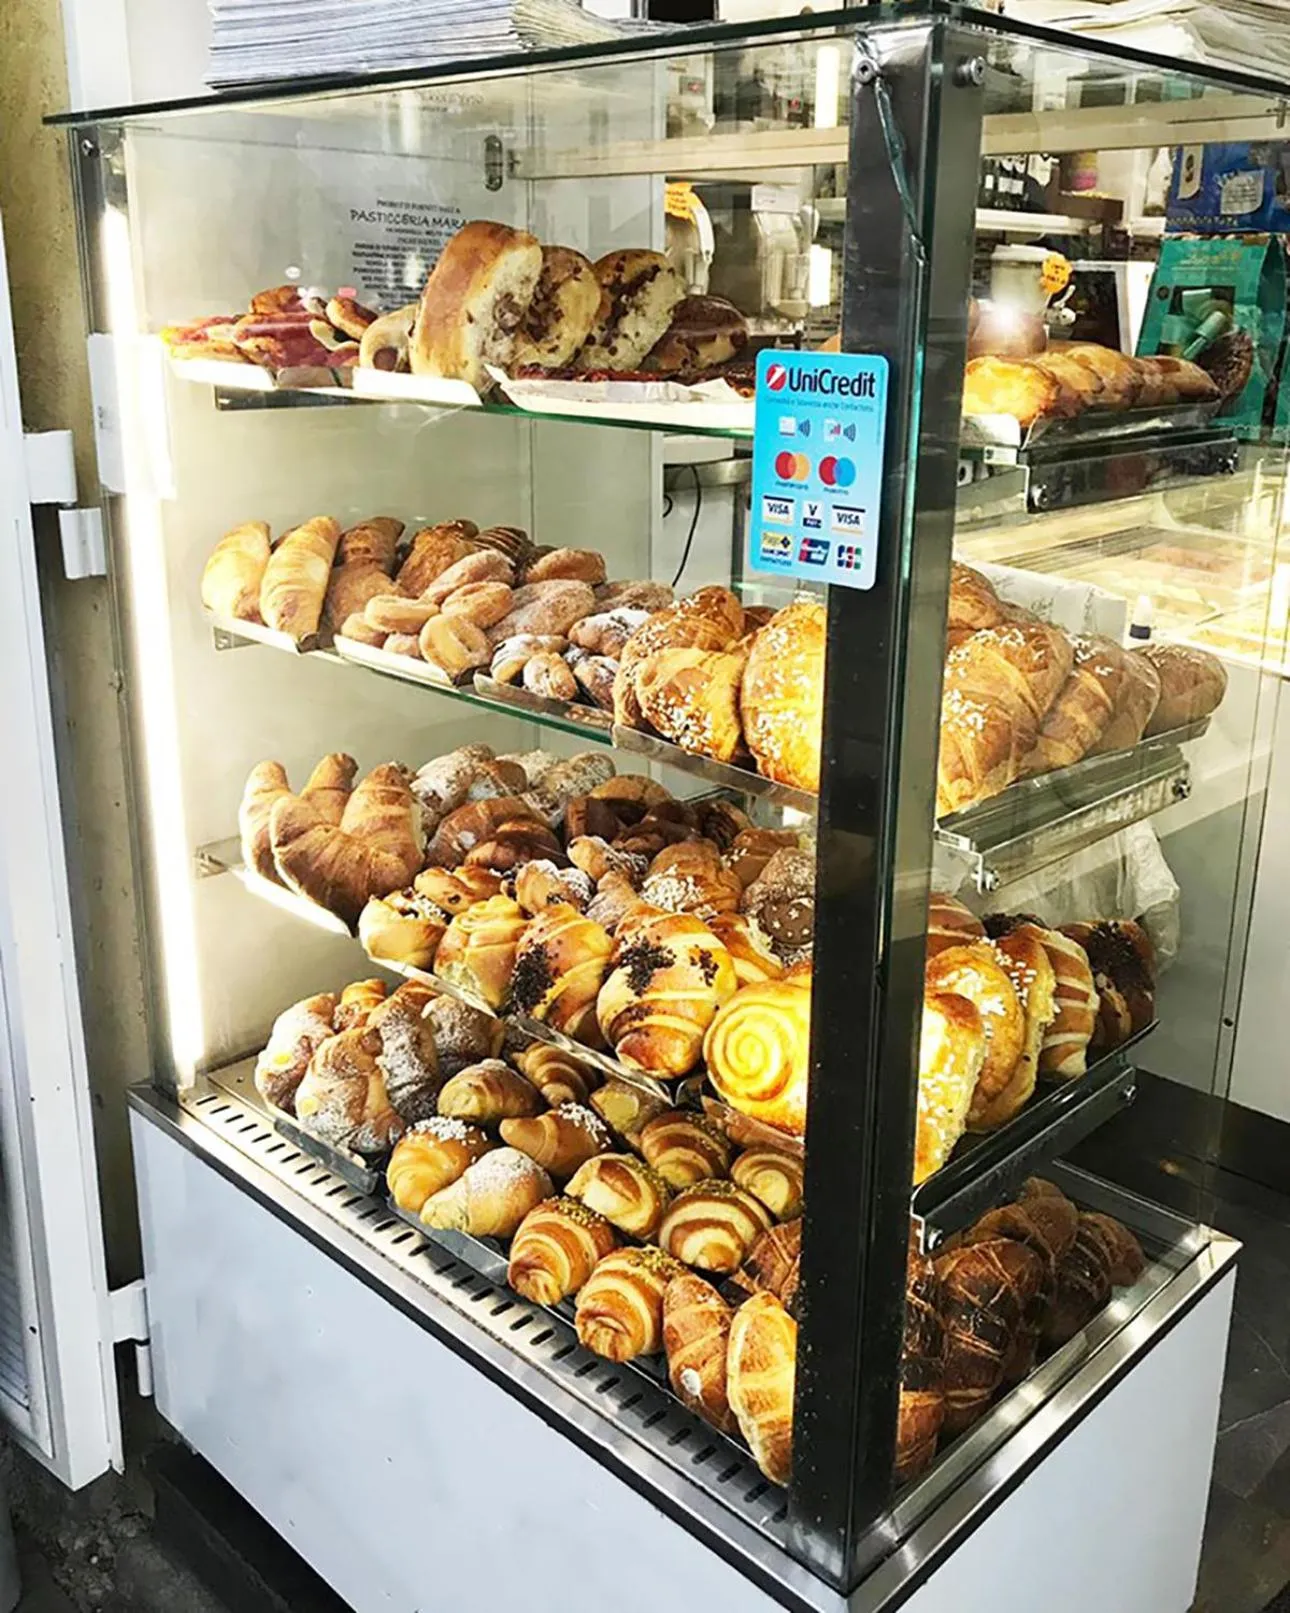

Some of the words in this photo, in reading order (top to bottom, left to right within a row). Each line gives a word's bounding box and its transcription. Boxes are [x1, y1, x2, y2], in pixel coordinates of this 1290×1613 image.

[350, 209, 430, 227] PASTICCERIA
[789, 367, 876, 398] UniCredit
[767, 503, 790, 515] VISA
[836, 512, 861, 525] VISA
